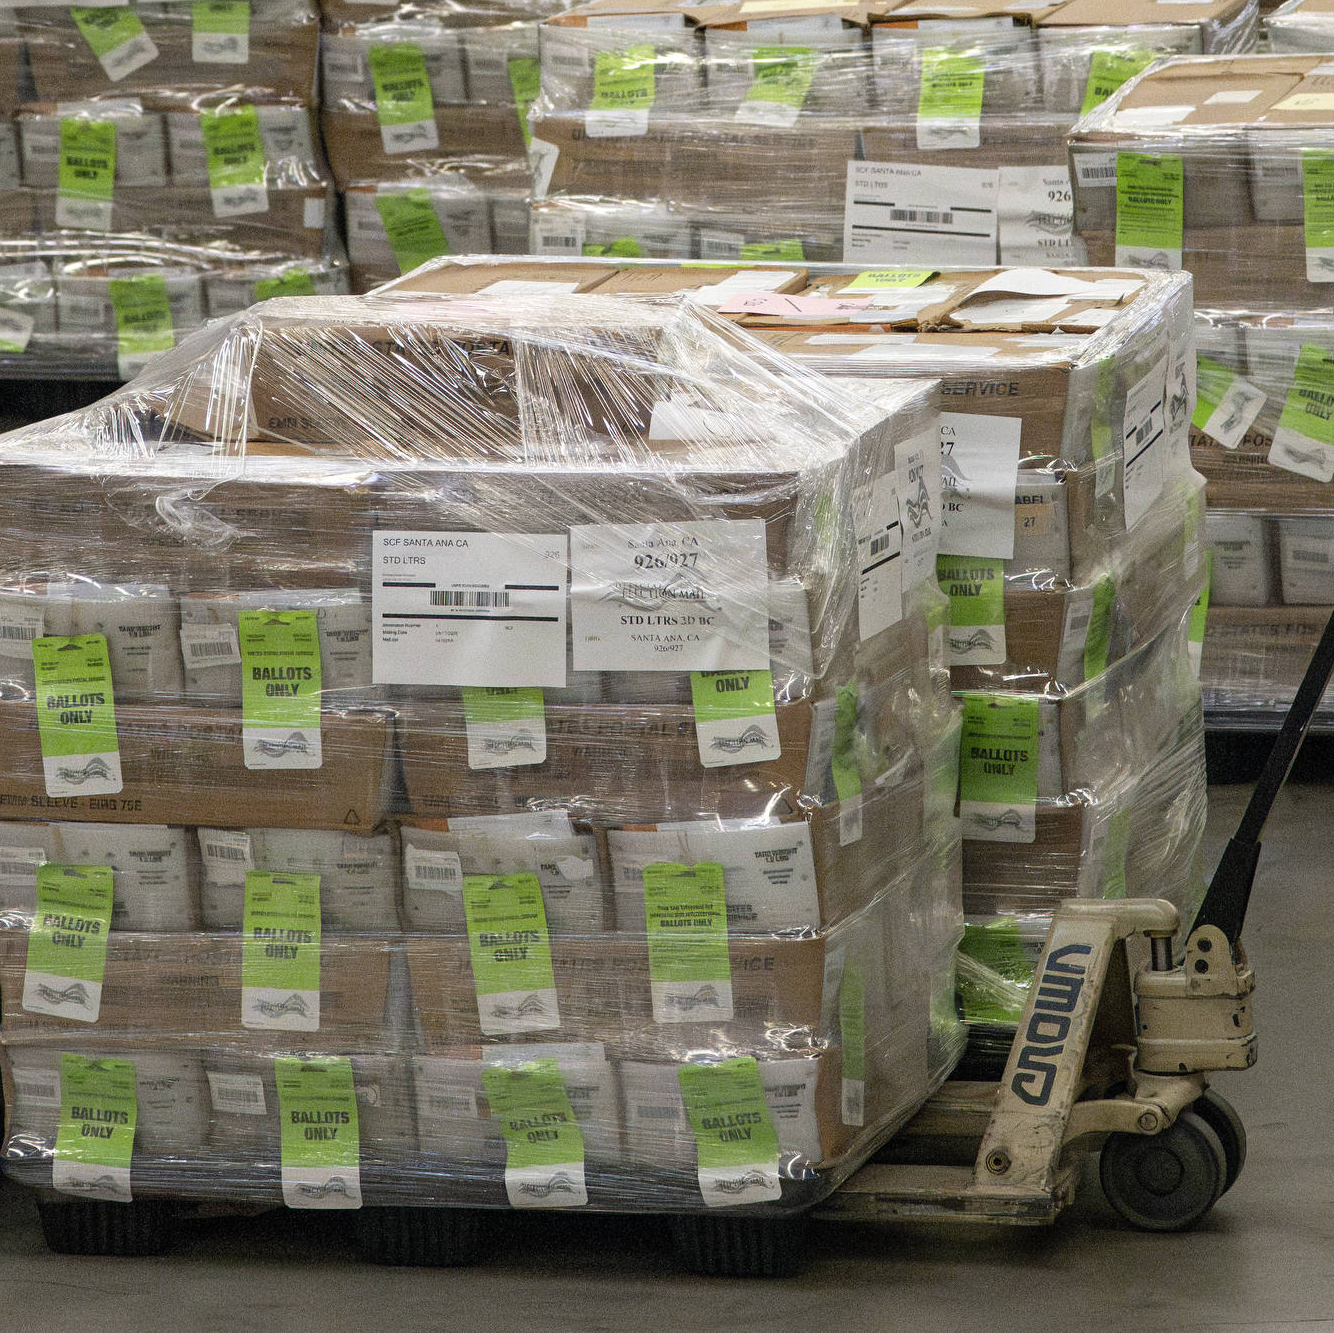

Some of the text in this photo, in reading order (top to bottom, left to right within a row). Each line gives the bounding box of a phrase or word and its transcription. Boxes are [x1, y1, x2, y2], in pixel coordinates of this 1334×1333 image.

[941, 380, 1021, 397] SERVICE
[949, 503, 964, 513] BC
[1023, 516, 1036, 527] 27
[383, 538, 469, 548] SCF SANTA ANA CA
[681, 536, 700, 548] CA
[383, 555, 426, 565] STD LTRS
[634, 552, 699, 569] 926/927
[949, 583, 983, 598] ONLY
[620, 614, 715, 626] STD LTRS BC
[630, 633, 700, 644] SANTA ANA, CA
[653, 644, 684, 653] 926/927
[252, 666, 312, 681] BALLOTS
[265, 683, 300, 697] ONLY
[714, 676, 750, 693] ONLY
[47, 692, 105, 709] BALLOTS
[60, 710, 93, 725] ONLY
[970, 748, 1028, 762] BALLOTS
[983, 762, 1016, 776] ONLY
[43, 913, 101, 935] BALLOTS
[52, 930, 86, 948] ONLY
[253, 927, 313, 944] BALLOTS
[266, 944, 298, 960] ONLY
[1011, 944, 1091, 1107] CROWN
[70, 1105, 129, 1124] BALLOTS
[290, 1110, 350, 1124] BALLOTS
[509, 1112, 567, 1131] BALLOTS
[701, 1111, 761, 1128] BALLOTS
[80, 1123, 114, 1140] ONLY
[304, 1127, 338, 1141] ONLY
[527, 1130, 558, 1144] ONLY
[719, 1127, 752, 1142] ONLY
